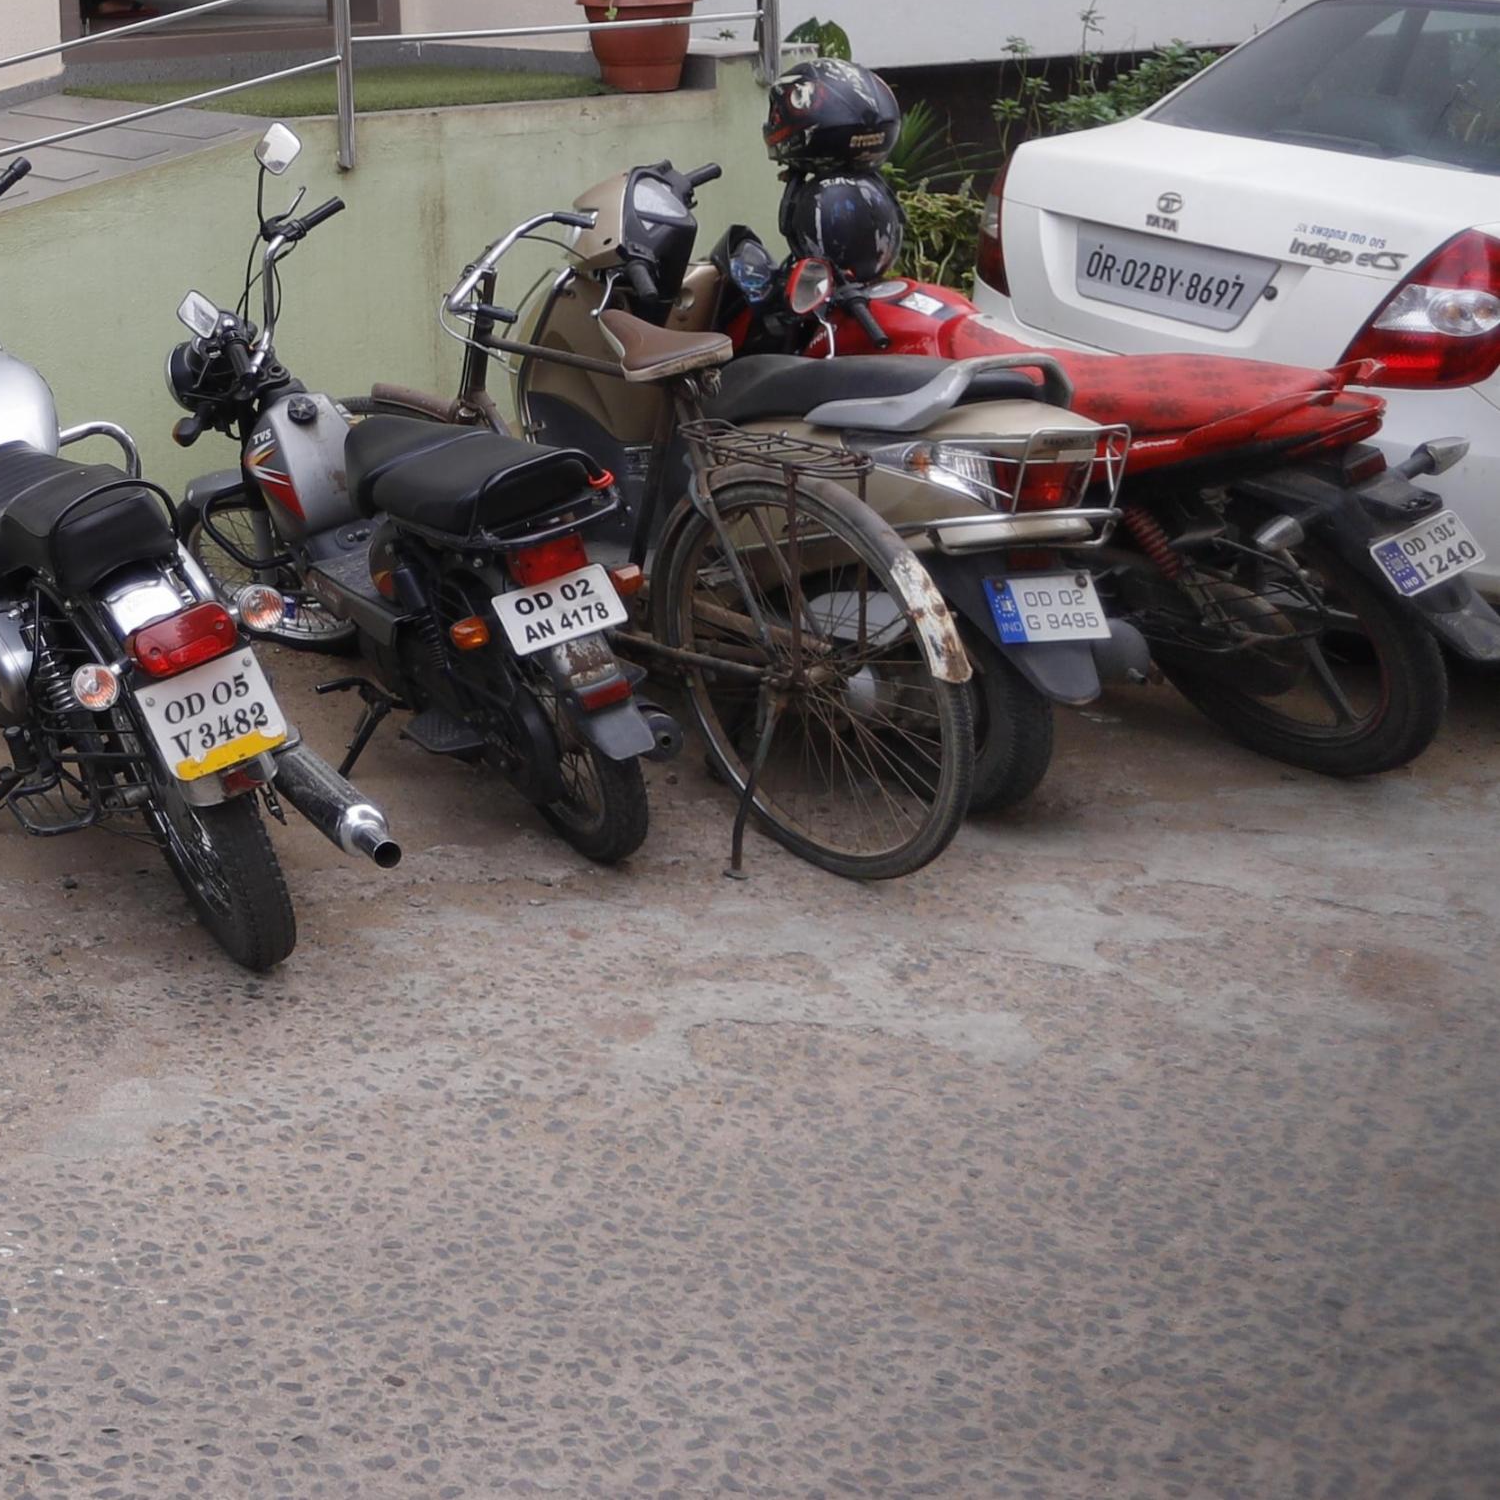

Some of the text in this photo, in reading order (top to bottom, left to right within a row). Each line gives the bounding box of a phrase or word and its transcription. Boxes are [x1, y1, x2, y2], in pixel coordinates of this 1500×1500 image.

[1145, 214, 1178, 233] TATA
[1289, 238, 1353, 265] Indigo
[253, 428, 272, 445] TVS
[1402, 537, 1426, 556] OD
[1416, 540, 1476, 580] 1240
[514, 579, 594, 615] OD 02
[1023, 590, 1085, 607] OD 02
[525, 602, 609, 643] AN 4178
[1046, 612, 1099, 629] 9495
[164, 692, 206, 724] OD
[171, 702, 269, 758] V 3482
